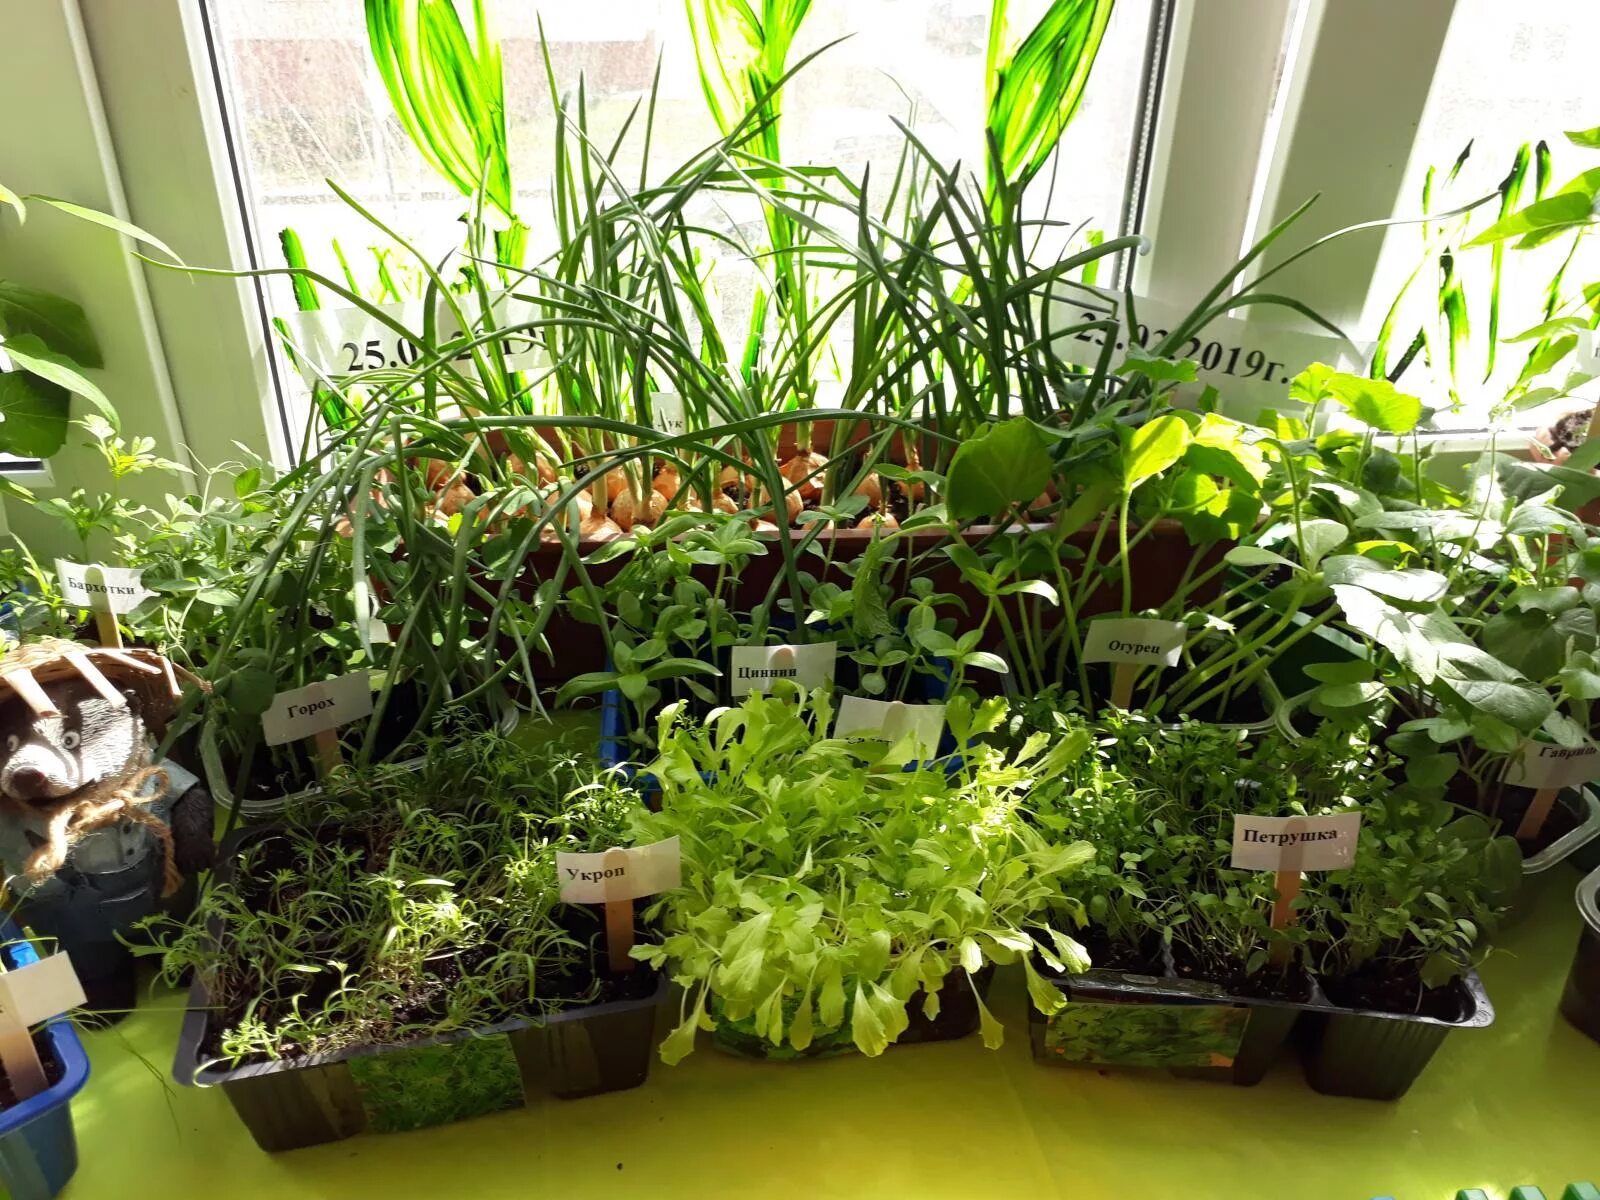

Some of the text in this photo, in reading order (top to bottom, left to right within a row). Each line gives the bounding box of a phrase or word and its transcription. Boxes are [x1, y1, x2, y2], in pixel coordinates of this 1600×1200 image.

[67, 577, 136, 595] Бархотки
[1108, 640, 1161, 655] Огурец
[737, 667, 798, 680] Циннии
[287, 697, 336, 719] Горох
[1242, 829, 1339, 847] Петрушка
[565, 866, 626, 883] Укроп
